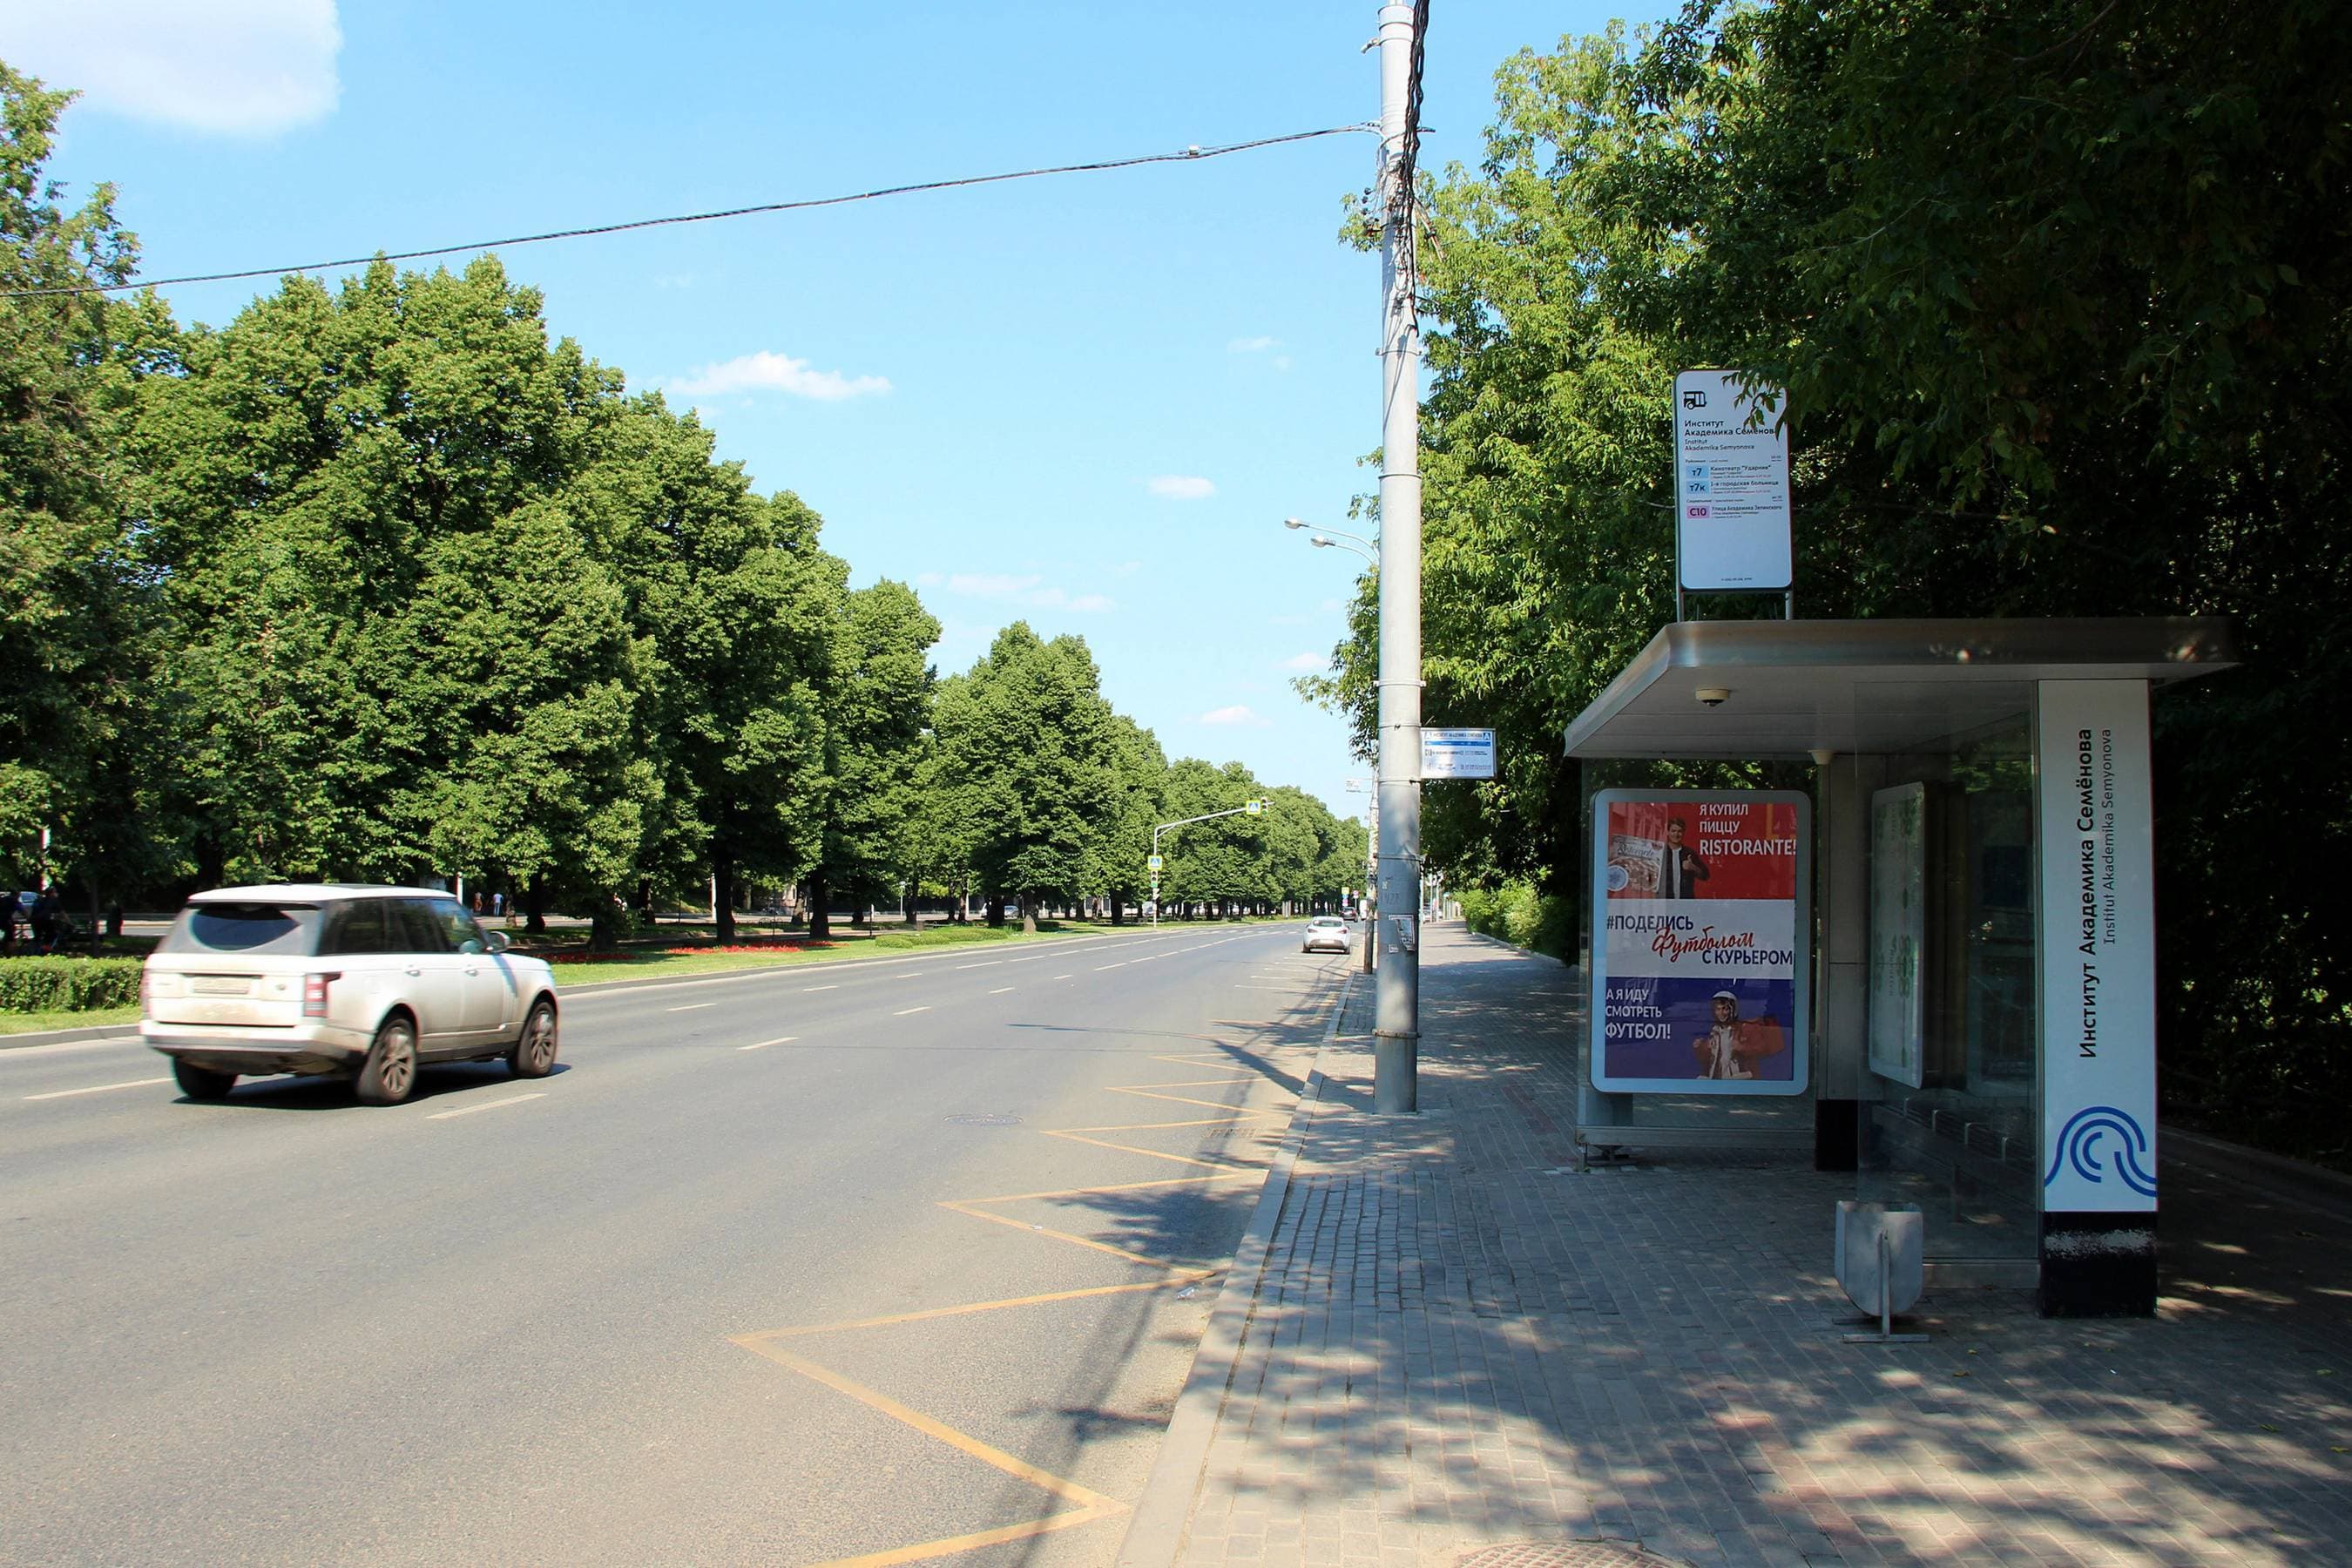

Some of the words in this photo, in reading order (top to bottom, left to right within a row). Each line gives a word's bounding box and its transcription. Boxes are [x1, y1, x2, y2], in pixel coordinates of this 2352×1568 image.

[2101, 729, 2115, 808] Semyonova
[2076, 729, 2094, 832] Семёнова
[1700, 804, 1707, 815] Я
[1709, 804, 1748, 815] КУПИЛ
[1700, 821, 1740, 835] ПИЦЦУ
[1700, 839, 1796, 855] RISTORANTE!
[2102, 812, 2114, 890] Akademika
[2078, 839, 2099, 956] Академика
[1606, 916, 1694, 933] #ПОДЕЛИСЬ
[2103, 893, 2116, 944] Institut
[1702, 950, 1711, 964] С
[1714, 950, 1793, 964] КУРЬЕРОМ
[1605, 988, 1614, 1000] А
[1616, 989, 1624, 1000] Я
[1625, 989, 1649, 1003] ИДУ
[1605, 1005, 1662, 1017] СМОТРЕТЬ
[2079, 963, 2100, 1058] Институт
[1605, 1022, 1671, 1039] ФУТБОЛ!
